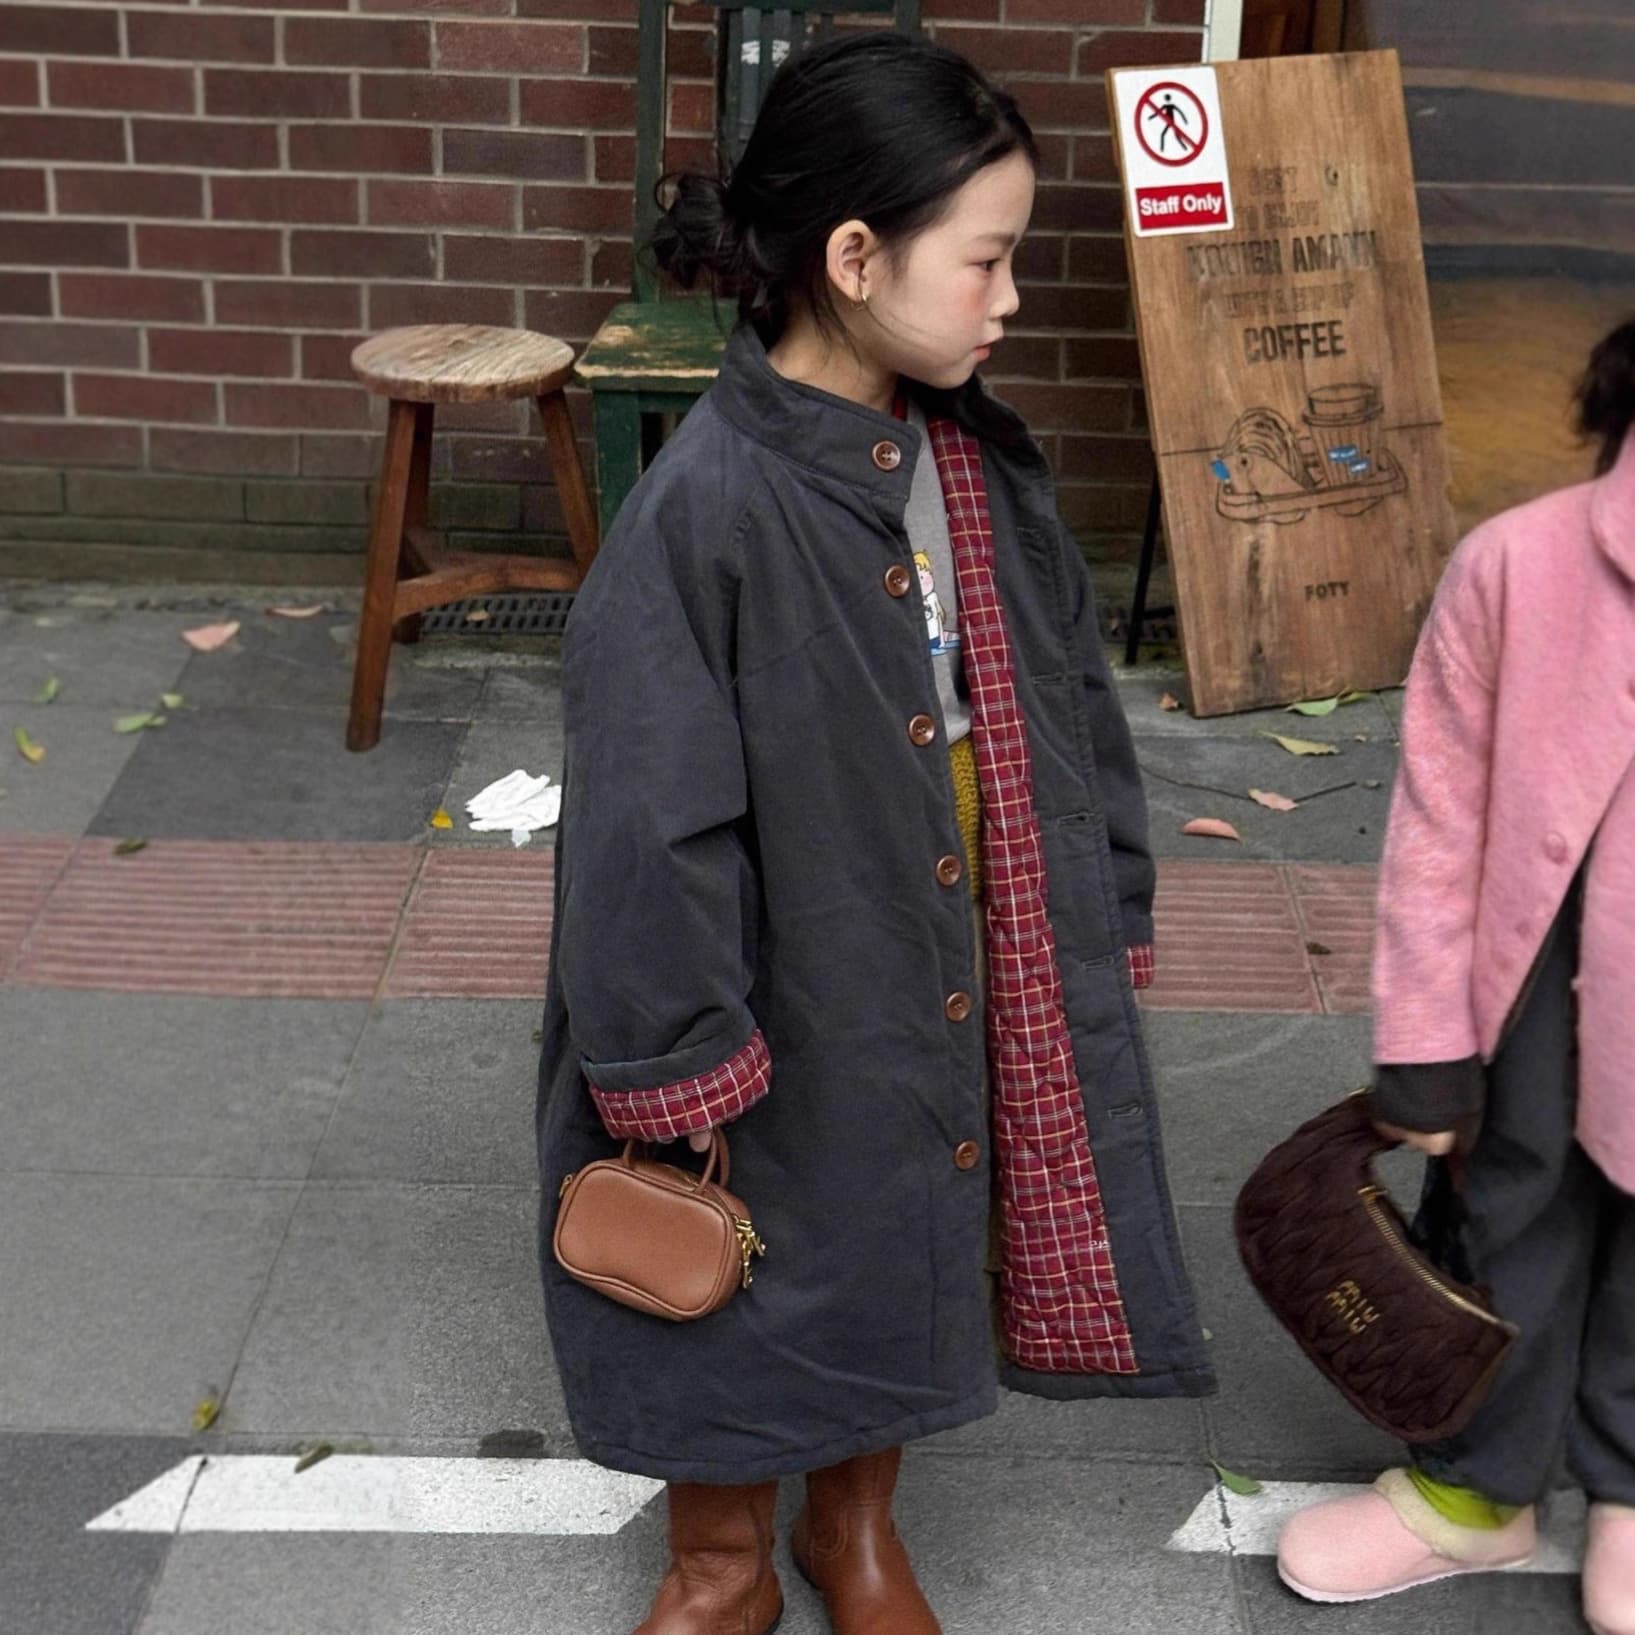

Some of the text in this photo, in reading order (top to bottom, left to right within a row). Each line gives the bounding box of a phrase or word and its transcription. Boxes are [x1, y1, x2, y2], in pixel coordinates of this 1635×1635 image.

[1140, 192, 1222, 216] Staff Only
[1244, 320, 1346, 364] COFFEE
